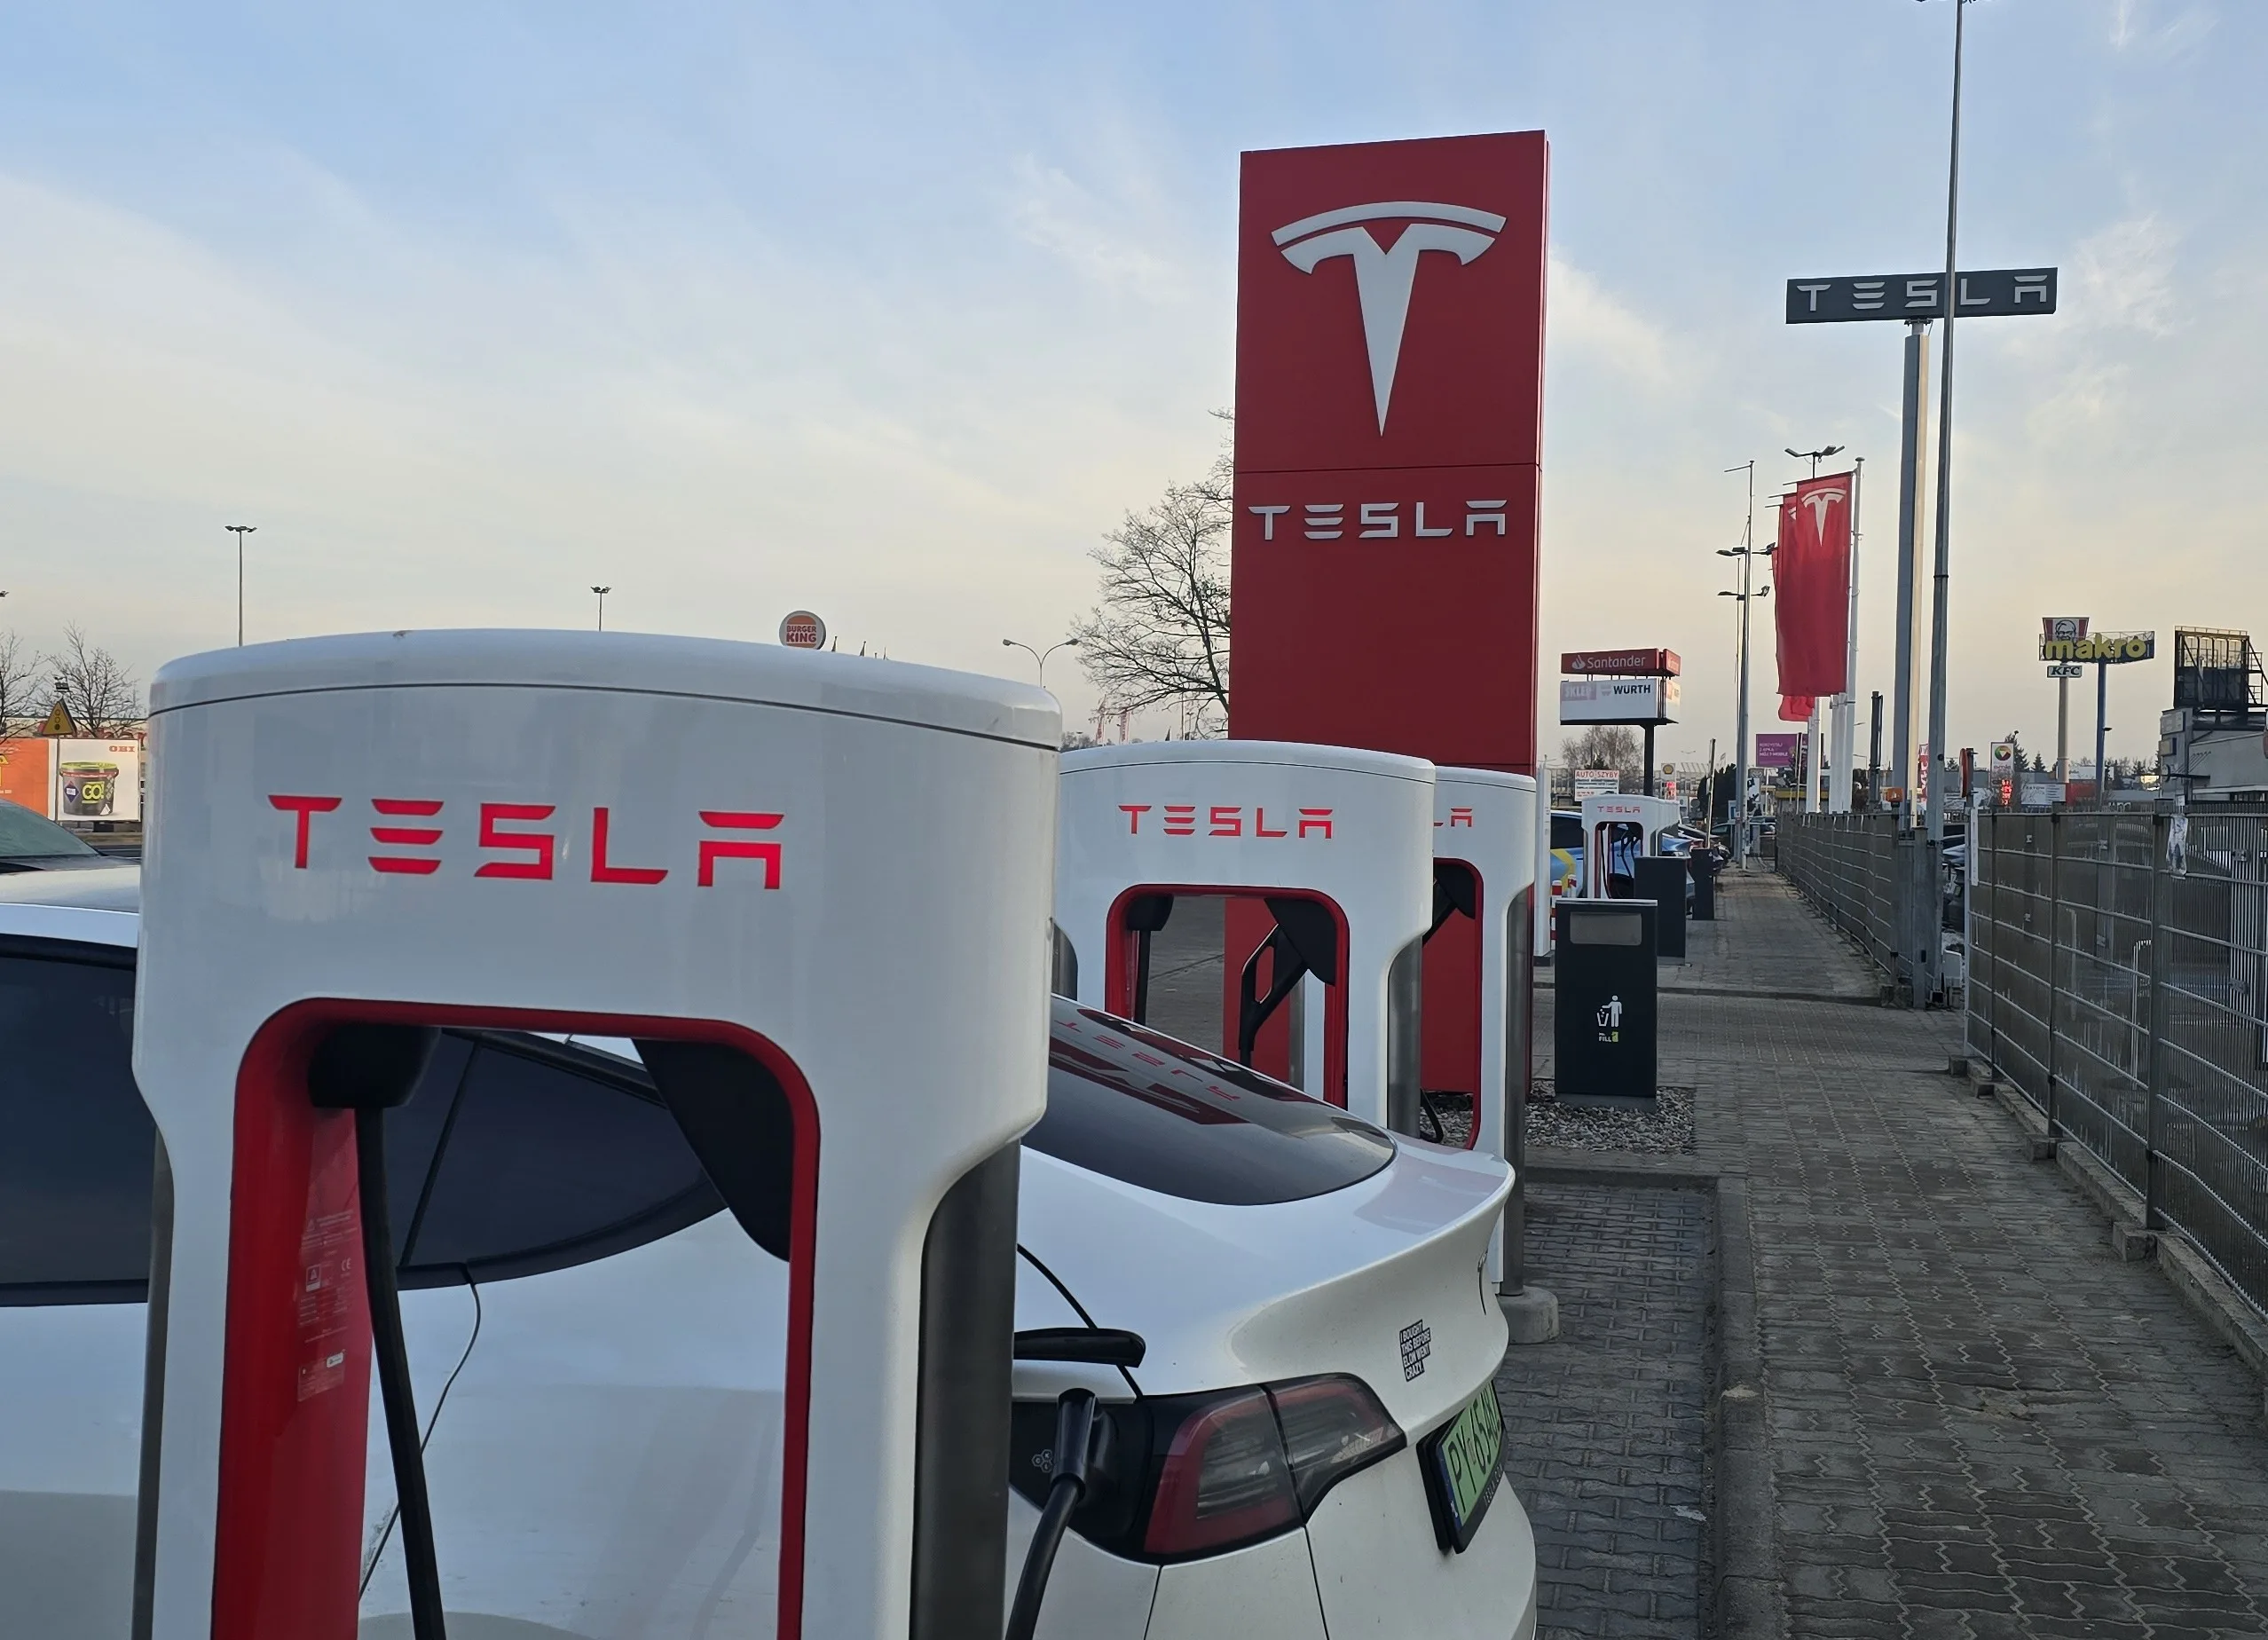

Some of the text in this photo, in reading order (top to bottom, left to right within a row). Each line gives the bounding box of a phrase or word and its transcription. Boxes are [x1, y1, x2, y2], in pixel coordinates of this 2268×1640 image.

[1796, 274, 2048, 311] TESLA
[1248, 500, 1508, 540] TESLA
[785, 633, 817, 643] KING
[2045, 632, 2146, 659] makro
[1587, 656, 1646, 669] Santander
[2051, 666, 2081, 675] KFC
[1118, 805, 1334, 840] TESLA
[268, 795, 784, 890] TESLA
[1401, 1340, 1413, 1355] THIS
[1403, 1343, 1429, 1368] ELON WENT
[1448, 1425, 1477, 1513] PY
